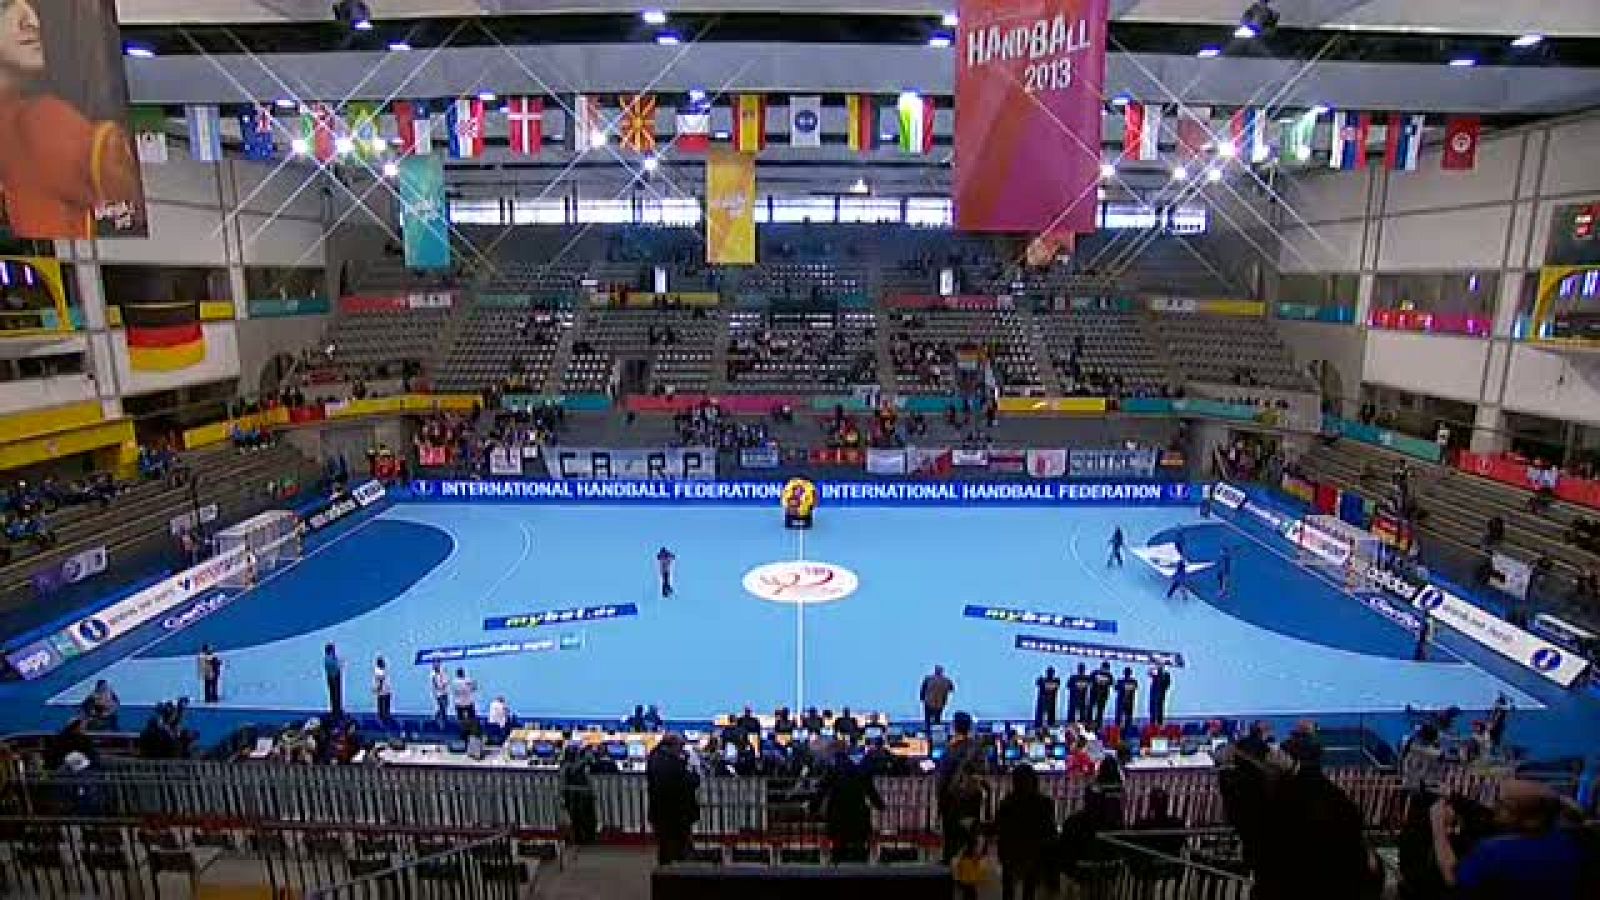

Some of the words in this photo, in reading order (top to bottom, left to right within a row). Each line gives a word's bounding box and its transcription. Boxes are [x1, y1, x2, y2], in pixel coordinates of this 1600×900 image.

[967, 12, 1091, 66] HANDBALL
[1024, 58, 1071, 93] 2013
[442, 482, 573, 496] INTERNATIONAL
[577, 482, 670, 498] HANDBALL
[675, 484, 782, 498] FEDERATION
[822, 484, 959, 499] INTERNATIONAL
[965, 484, 1055, 499] HANDBALL
[1059, 484, 1161, 499] FEDERATION
